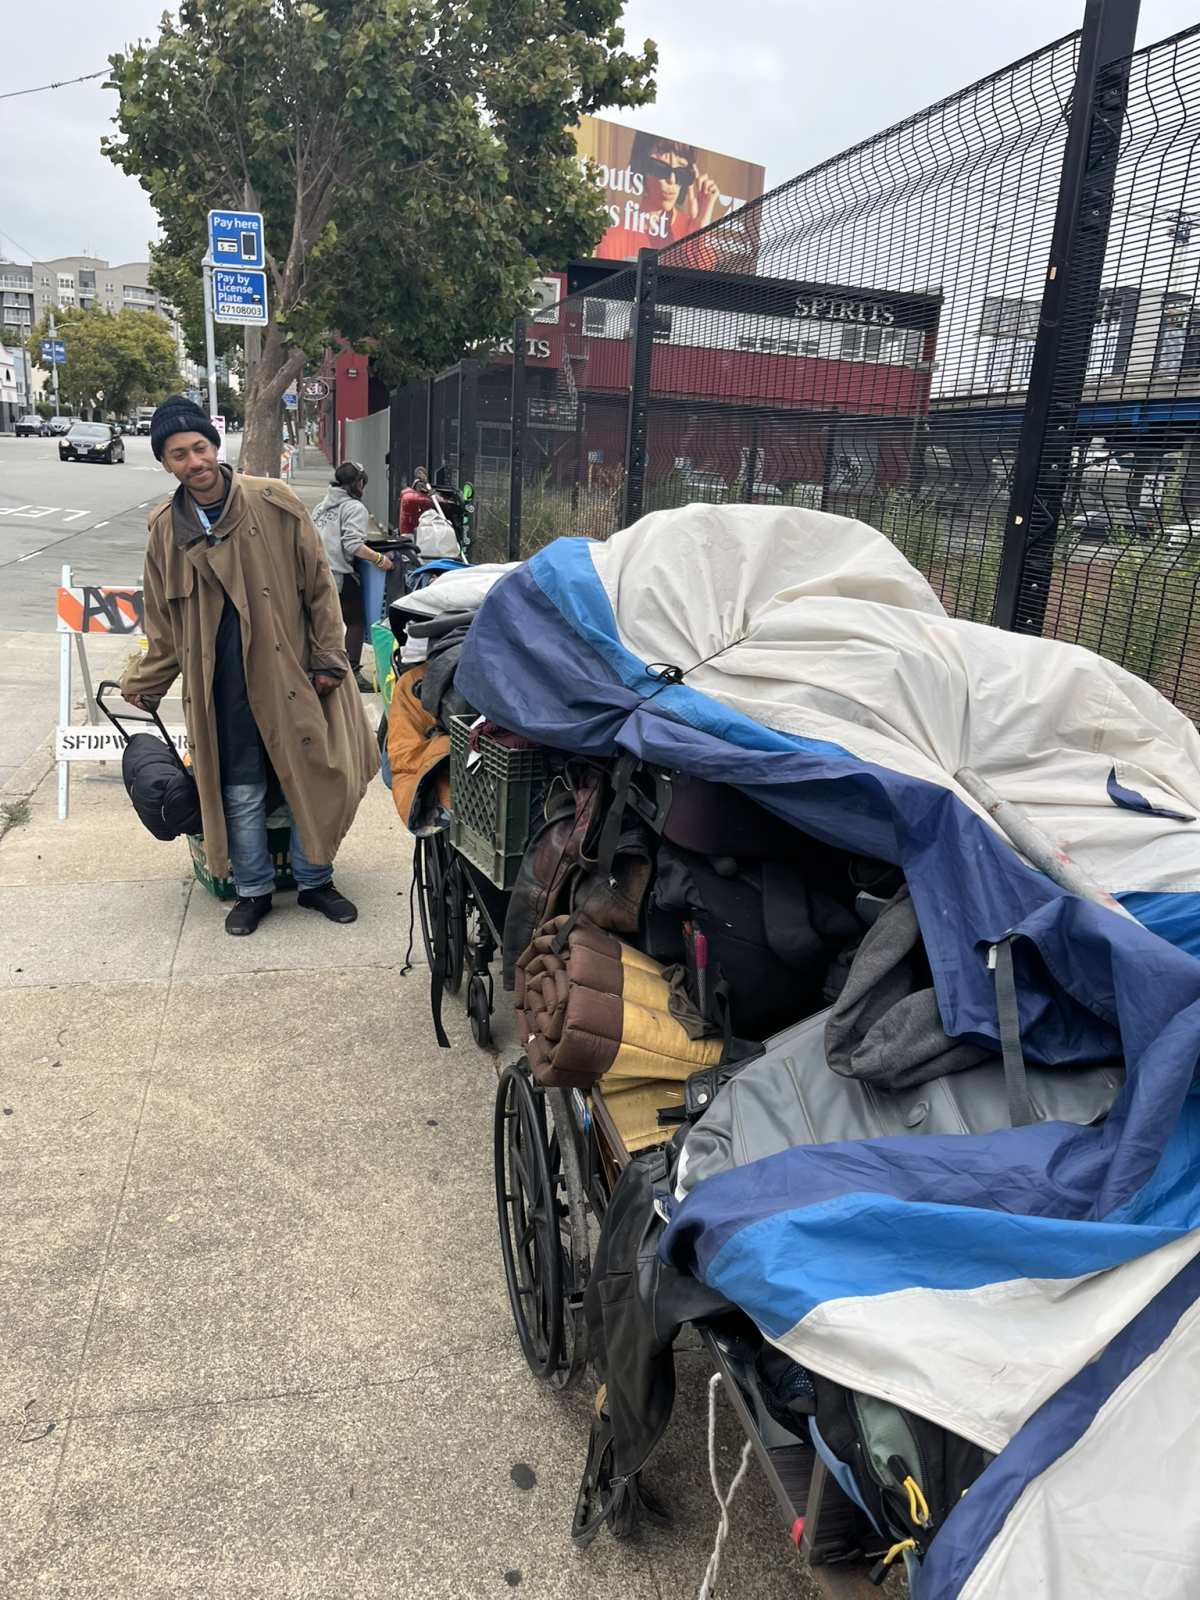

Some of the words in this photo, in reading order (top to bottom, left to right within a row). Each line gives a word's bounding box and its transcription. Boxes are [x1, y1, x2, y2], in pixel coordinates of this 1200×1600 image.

[214, 217, 234, 230] Pay
[235, 218, 259, 230] here
[624, 200, 669, 238] first
[217, 273, 235, 285] Pay
[237, 274, 250, 286] by
[218, 283, 253, 294] License
[218, 293, 243, 303] Plate
[220, 305, 262, 316] 47108003
[795, 296, 894, 325] SPIRITS
